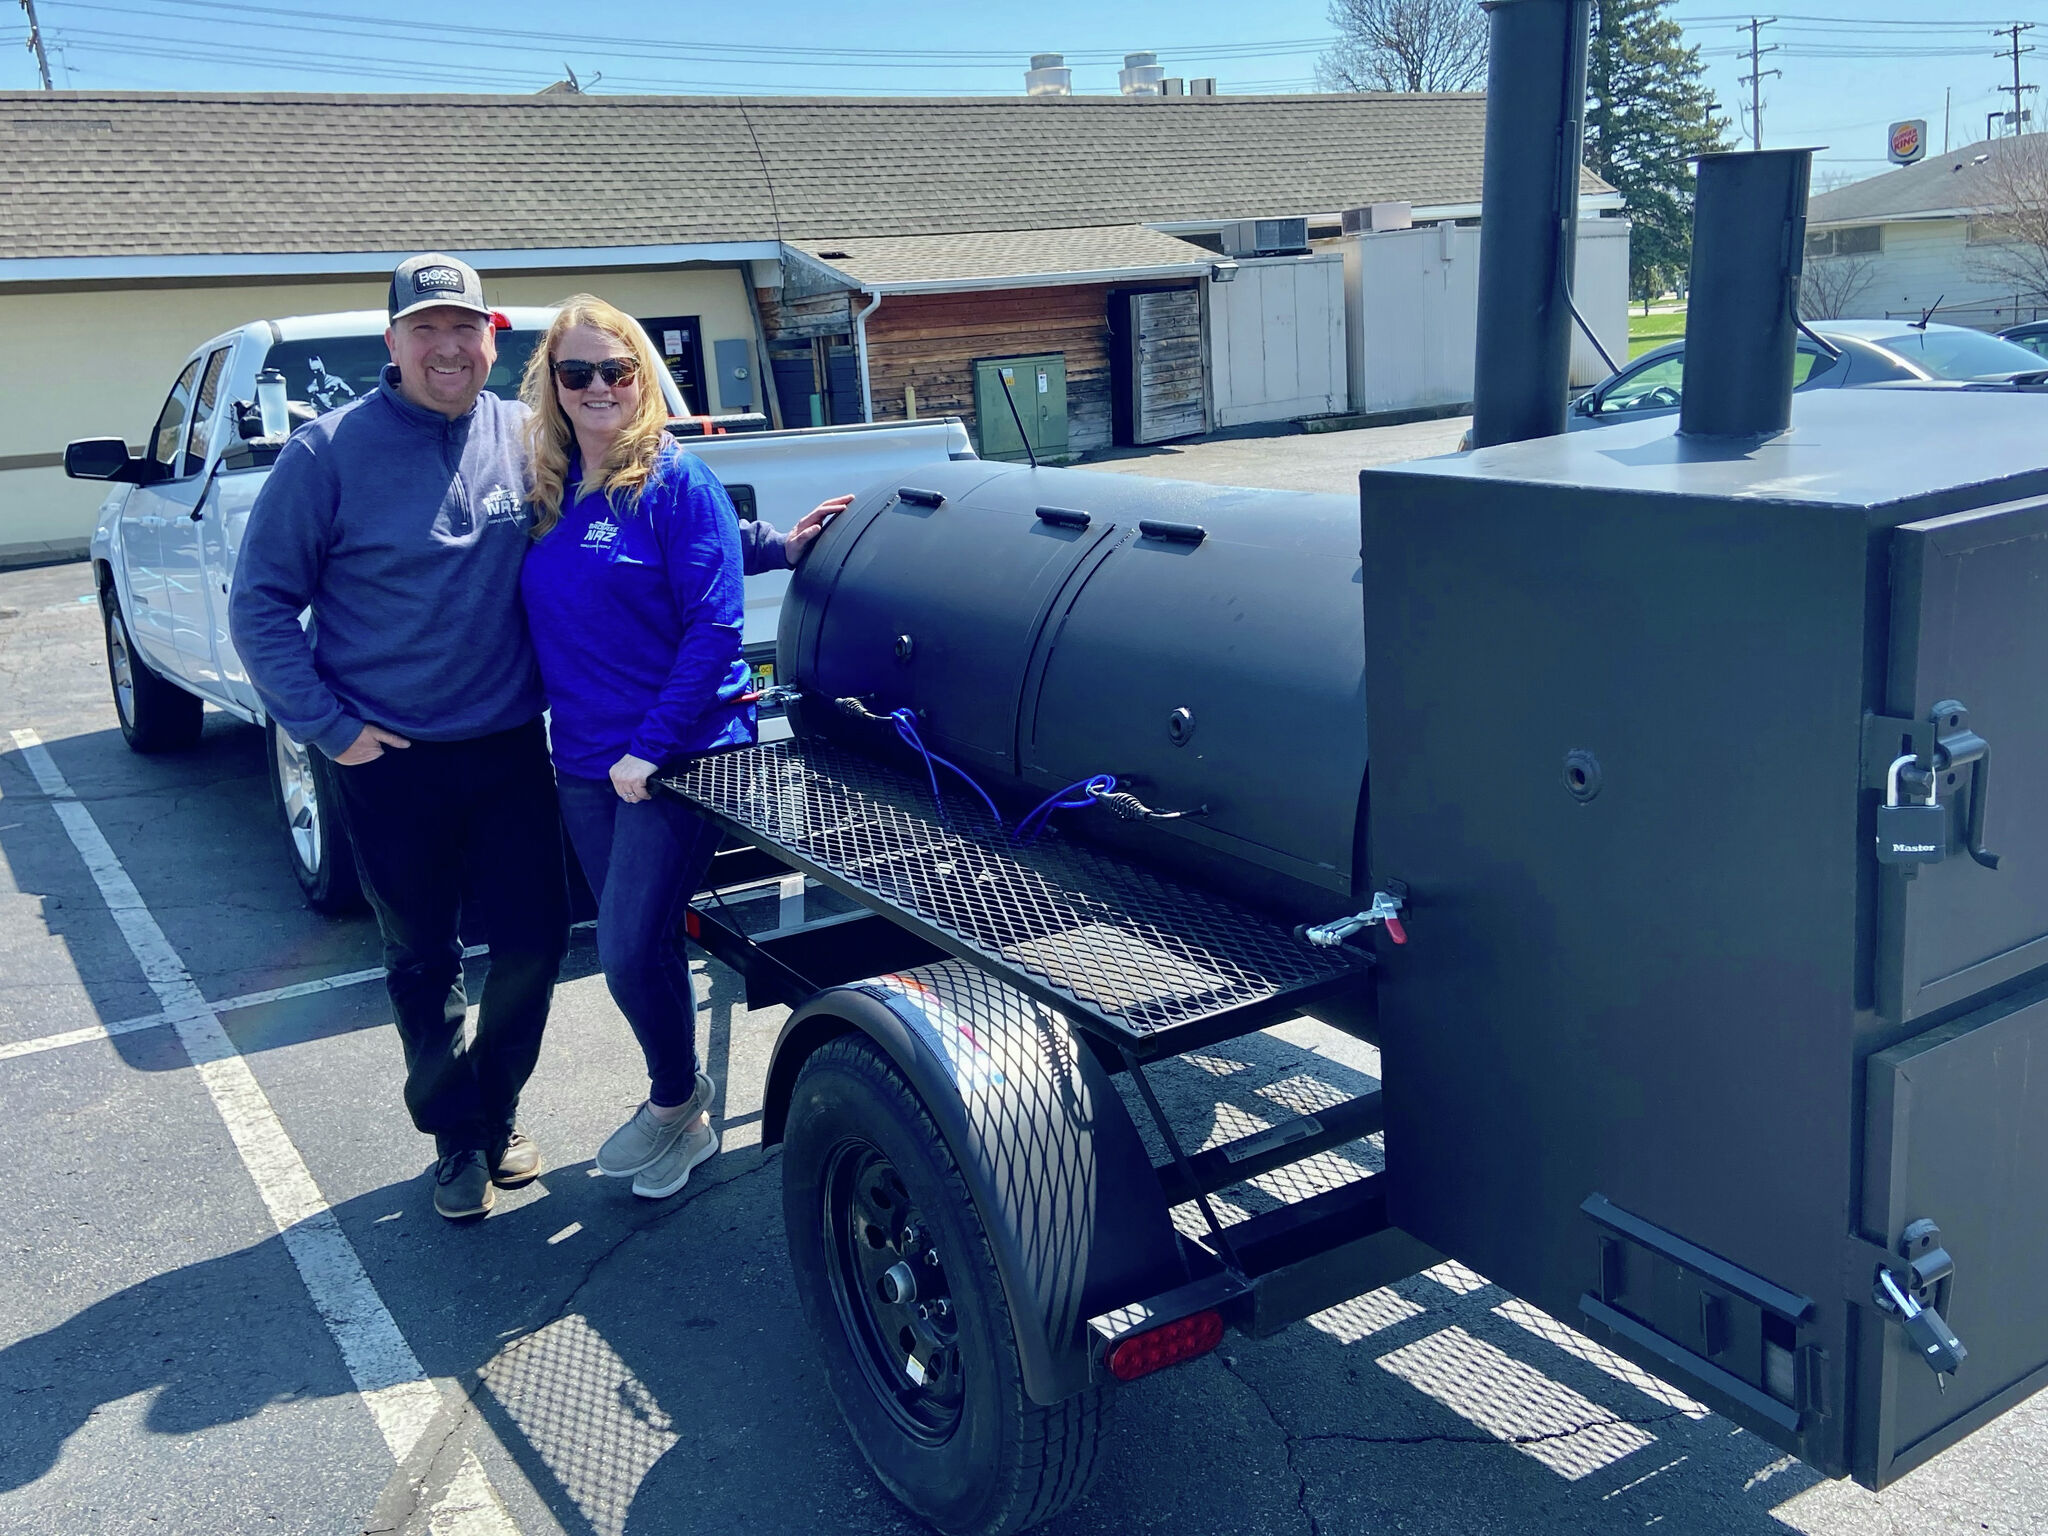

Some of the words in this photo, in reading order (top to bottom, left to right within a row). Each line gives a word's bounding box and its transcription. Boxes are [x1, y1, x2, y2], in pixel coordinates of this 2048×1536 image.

[1893, 128, 1917, 143] BURGER
[1895, 134, 1917, 150] KING
[419, 270, 459, 283] BOSS
[486, 498, 521, 516] NAZ
[584, 529, 617, 542] NAZ
[1893, 844, 1936, 852] Master
